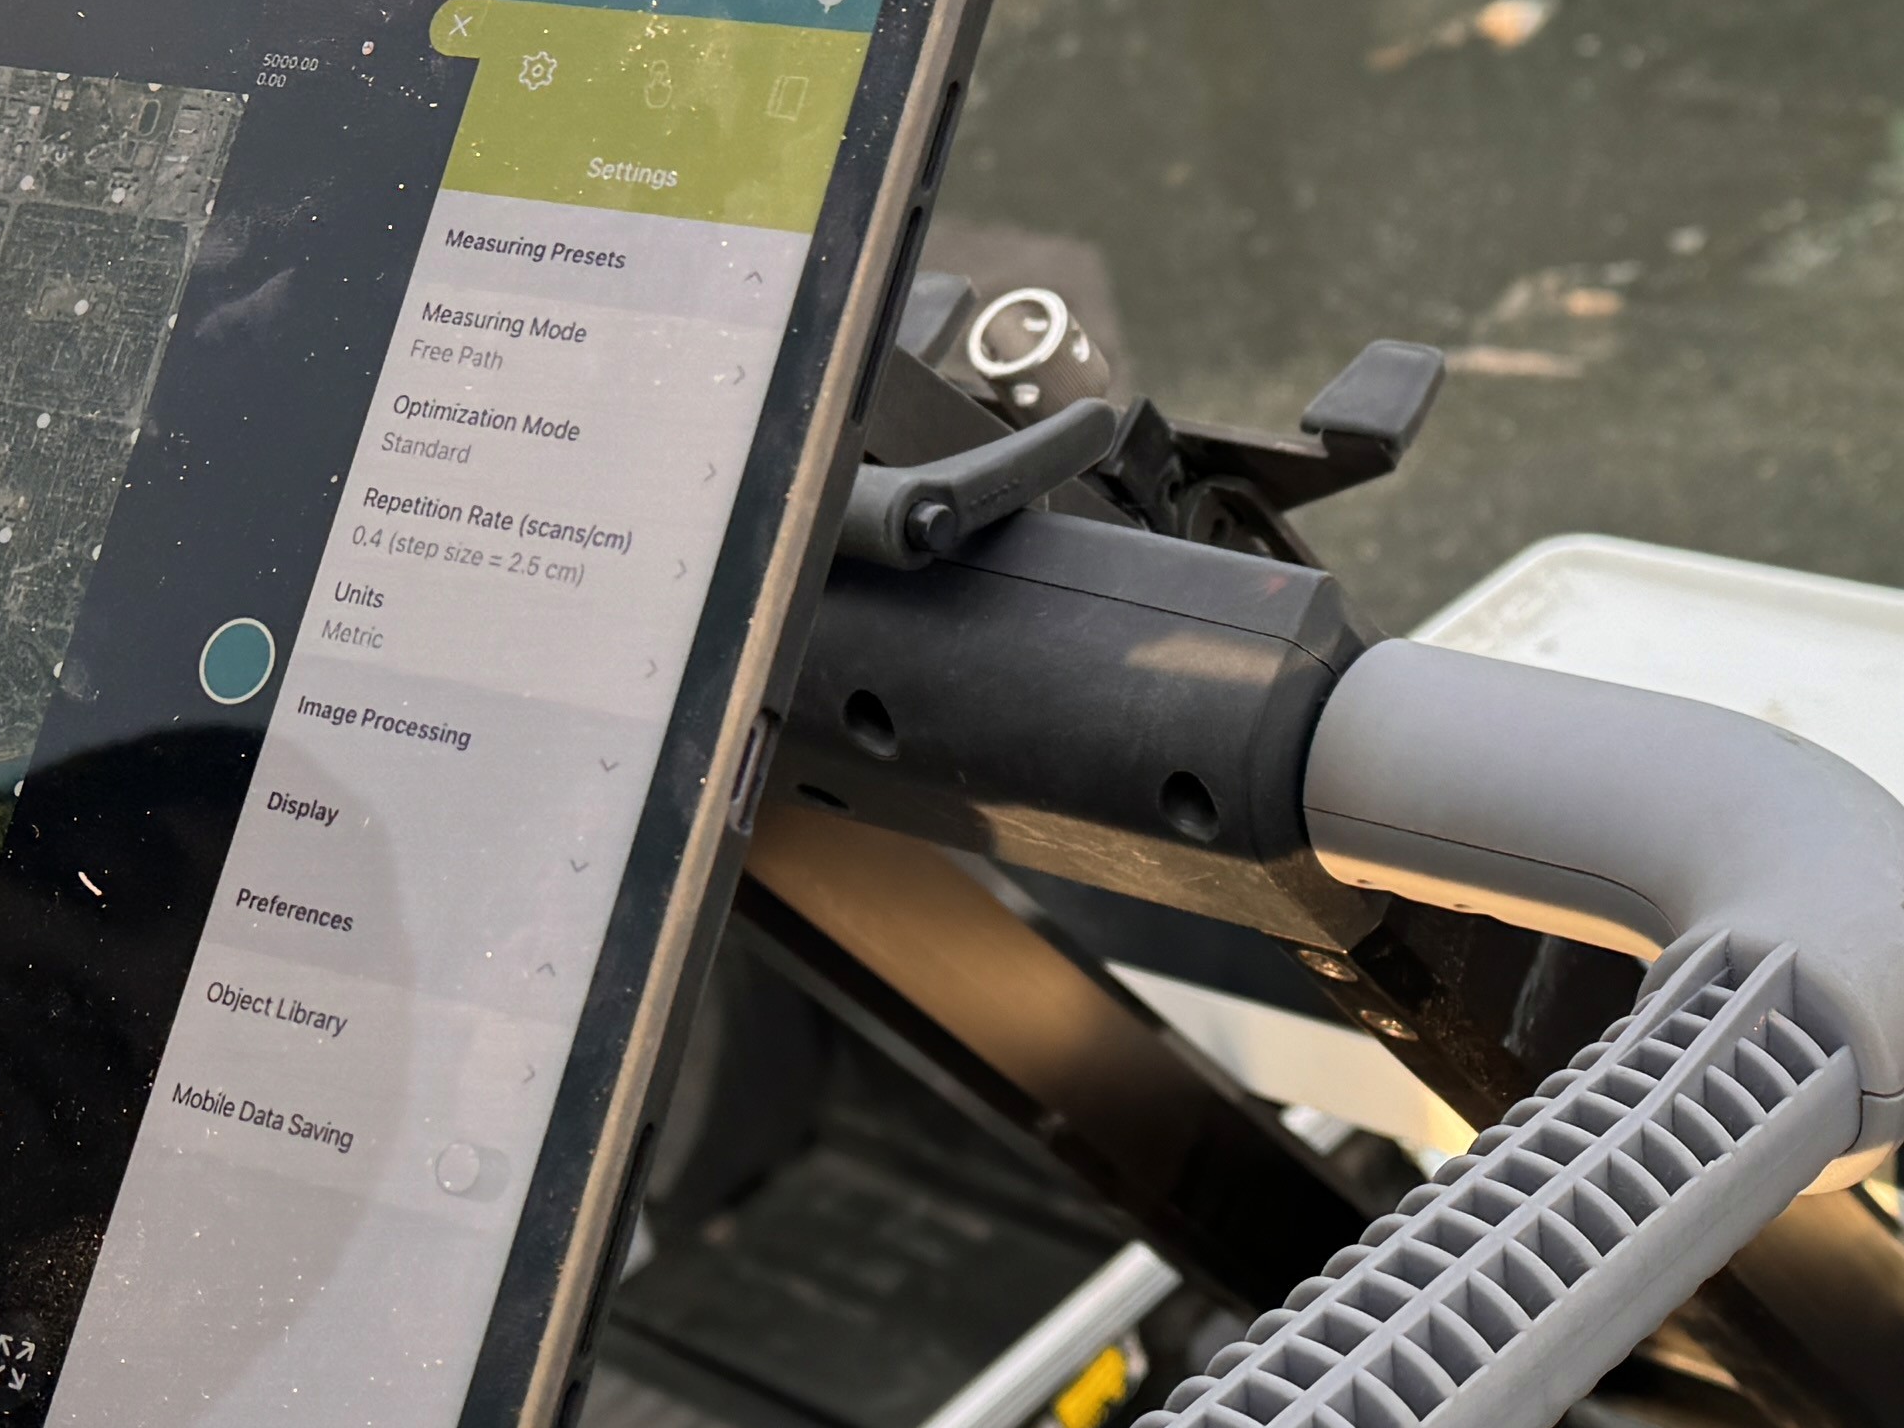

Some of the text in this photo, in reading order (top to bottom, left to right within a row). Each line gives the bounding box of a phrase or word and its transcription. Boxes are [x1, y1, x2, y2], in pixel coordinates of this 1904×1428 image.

[586, 156, 679, 190] Settings
[444, 228, 627, 271] Measuring Presets
[421, 301, 588, 344] Measuring Mode
[410, 339, 504, 371] Free Path
[392, 394, 582, 443] Optimization Mode
[380, 431, 472, 465] Standard
[363, 487, 634, 555] Repetition Rate (scans/cm)
[351, 524, 383, 550] 0.4
[387, 531, 440, 563] (step
[442, 540, 485, 566] size
[507, 551, 540, 578] 2.5
[543, 558, 586, 589] cm)
[334, 580, 385, 610] Units
[320, 618, 385, 651] Metric
[296, 694, 473, 752] Image Processing
[266, 790, 340, 829] Display
[235, 887, 355, 933] Preferences
[206, 980, 349, 1039] Object Library
[171, 1081, 356, 1154] Mobile Data Saving
